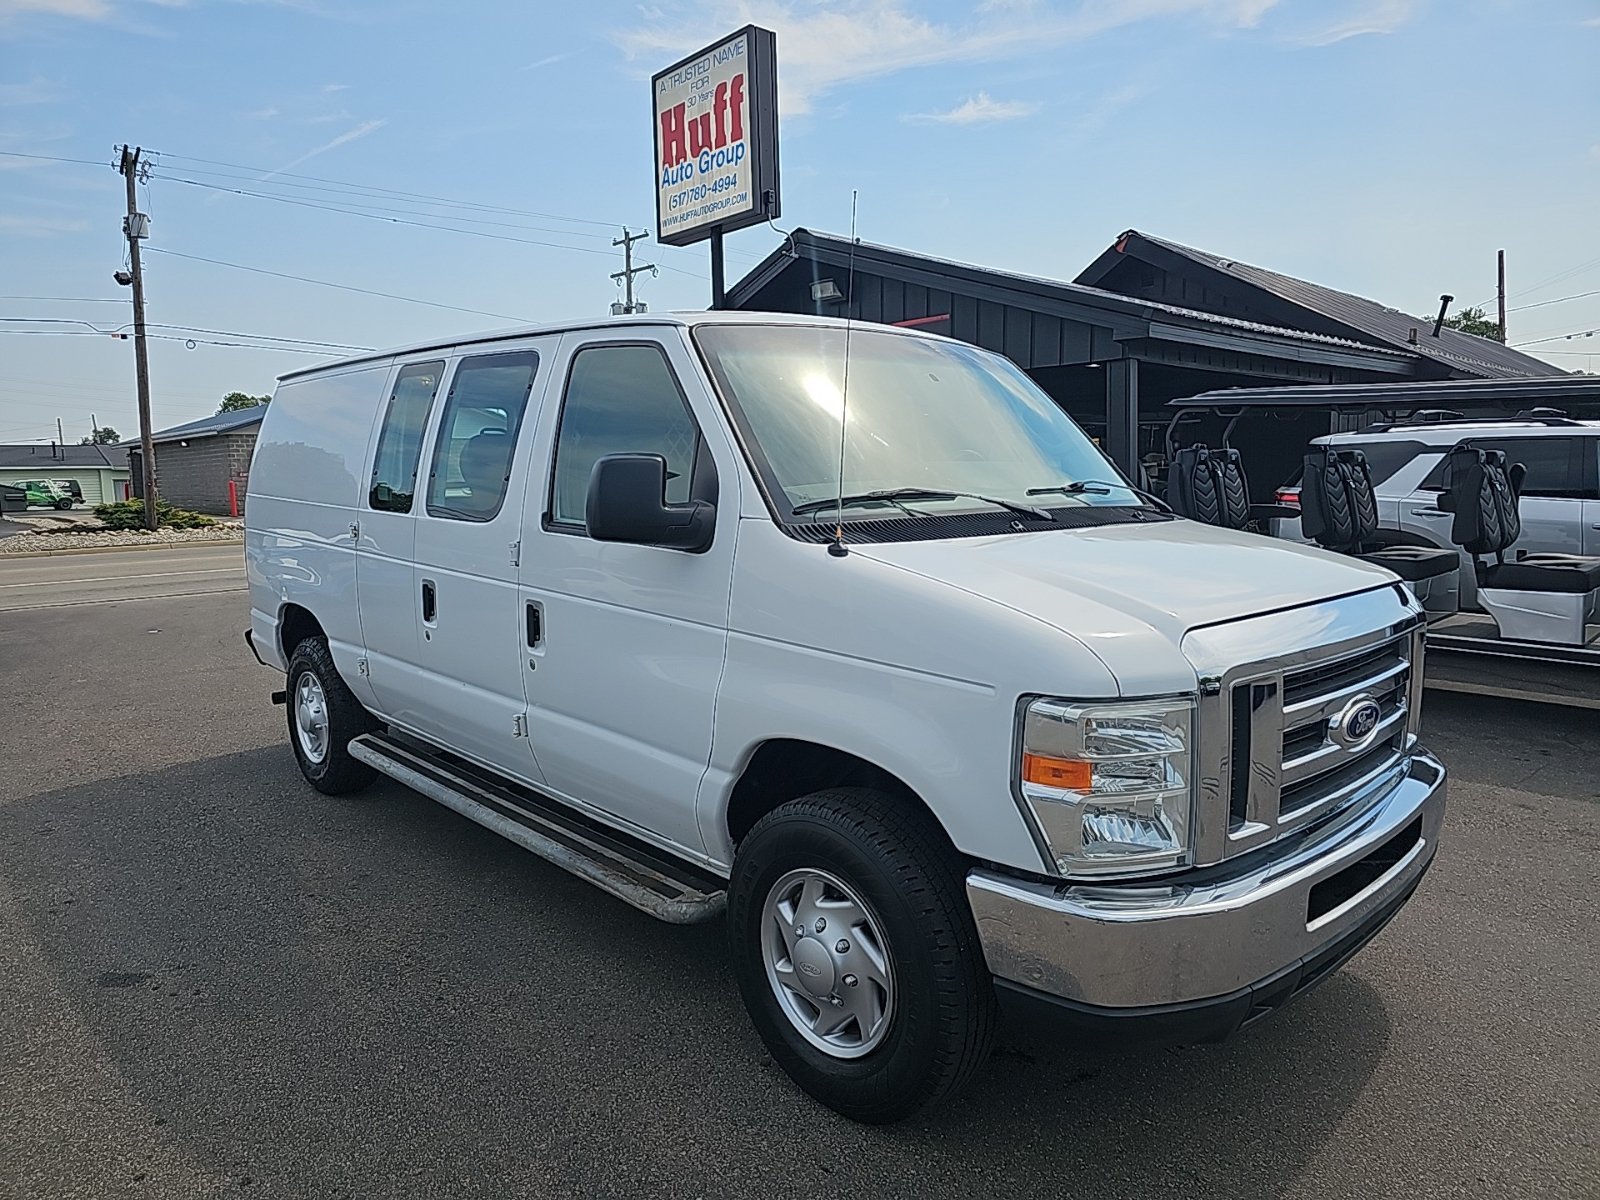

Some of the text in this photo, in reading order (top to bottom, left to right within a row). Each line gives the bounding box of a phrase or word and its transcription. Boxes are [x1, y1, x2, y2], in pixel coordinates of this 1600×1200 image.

[660, 39, 743, 94] A TRUSTED NAME
[690, 75, 710, 93] FOR
[661, 73, 744, 169] Huff
[687, 96, 696, 108] 30
[662, 142, 745, 189] Auto Group
[662, 192, 747, 227] WWW.HUFFAUTOGROUP.COM
[668, 173, 737, 211] (517)780-4994
